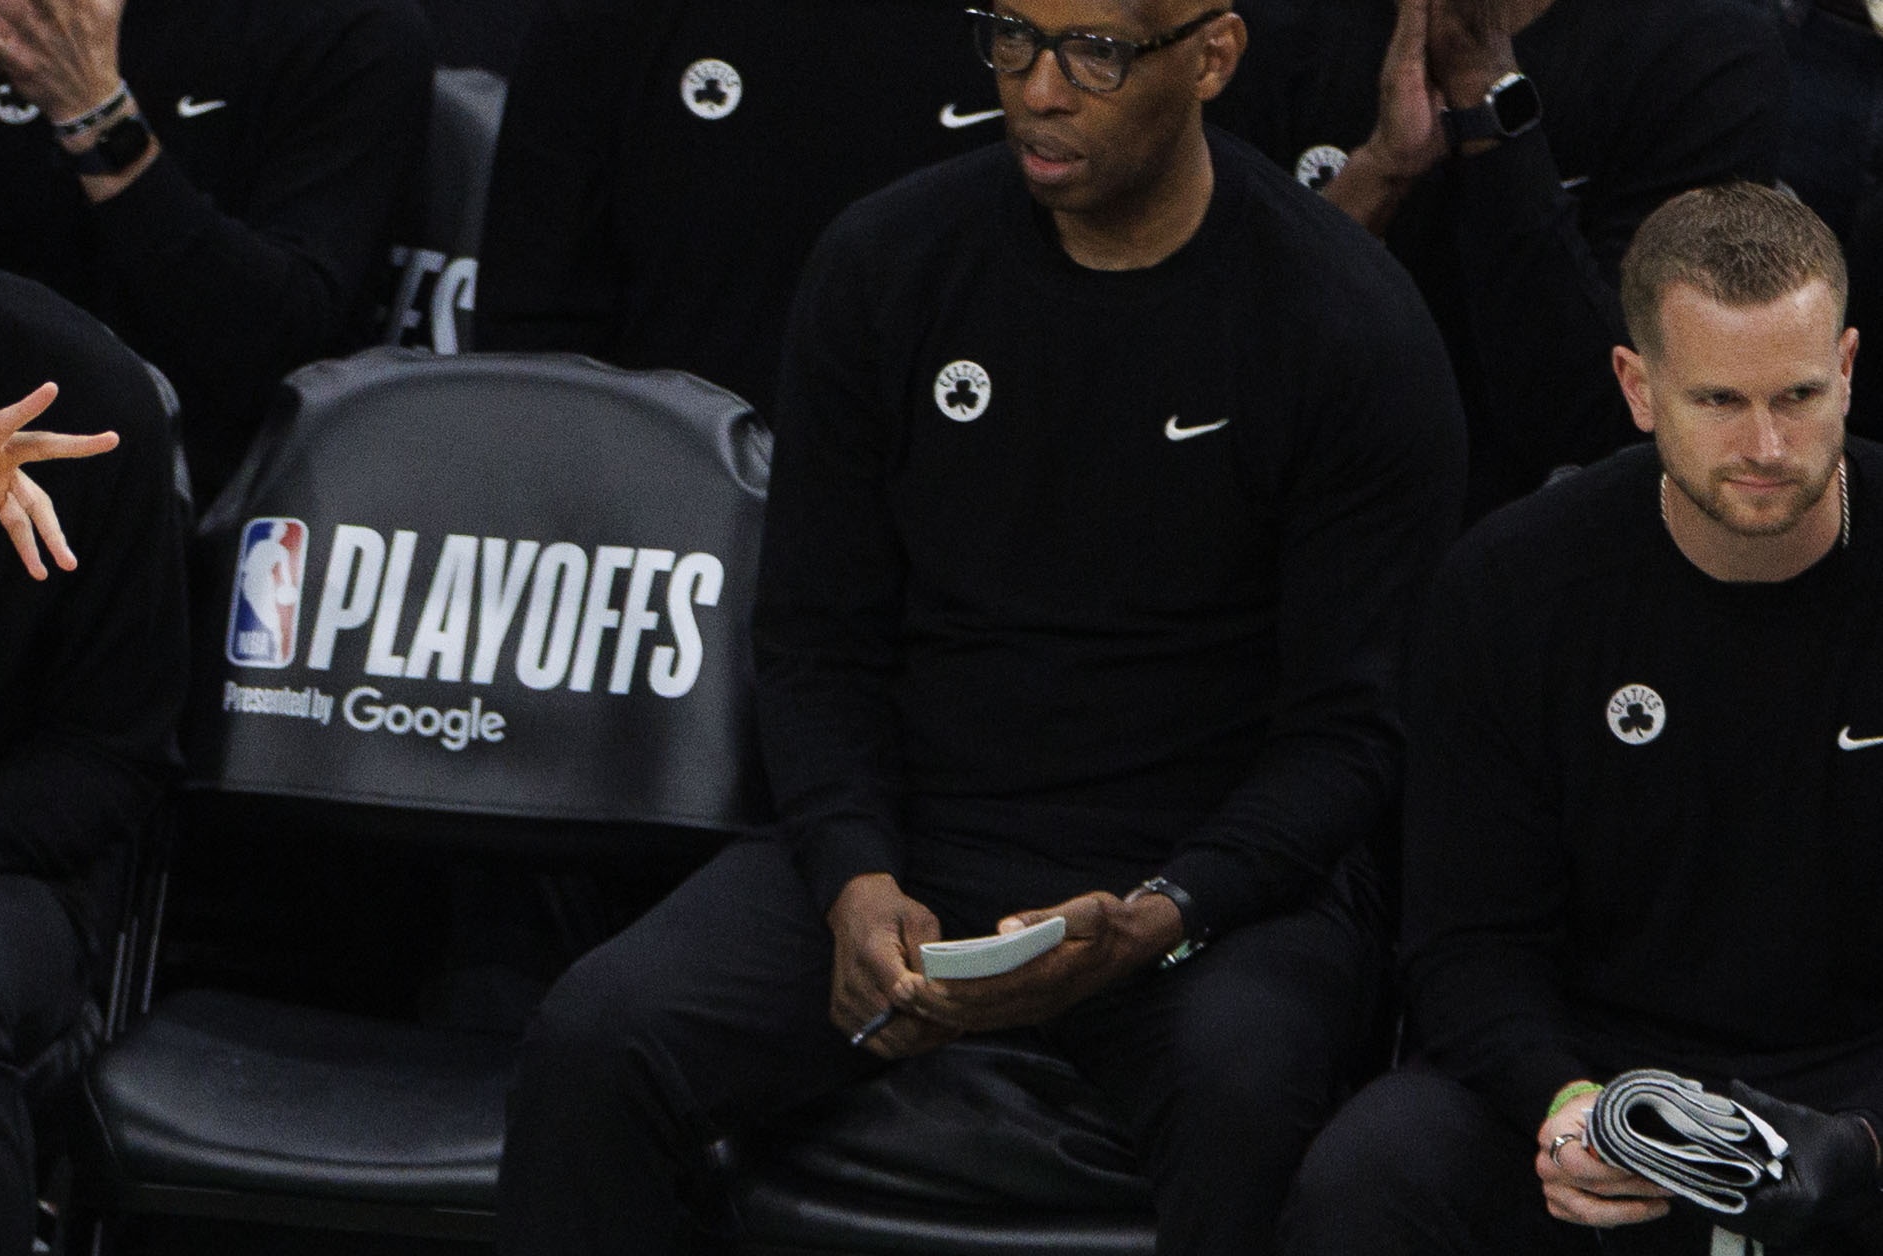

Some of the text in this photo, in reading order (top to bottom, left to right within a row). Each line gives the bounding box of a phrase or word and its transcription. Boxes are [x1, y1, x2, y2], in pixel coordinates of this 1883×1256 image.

[308, 524, 724, 699] PLAYOFFS
[343, 686, 507, 752] Google
[1610, 687, 1662, 714] CELTICS
